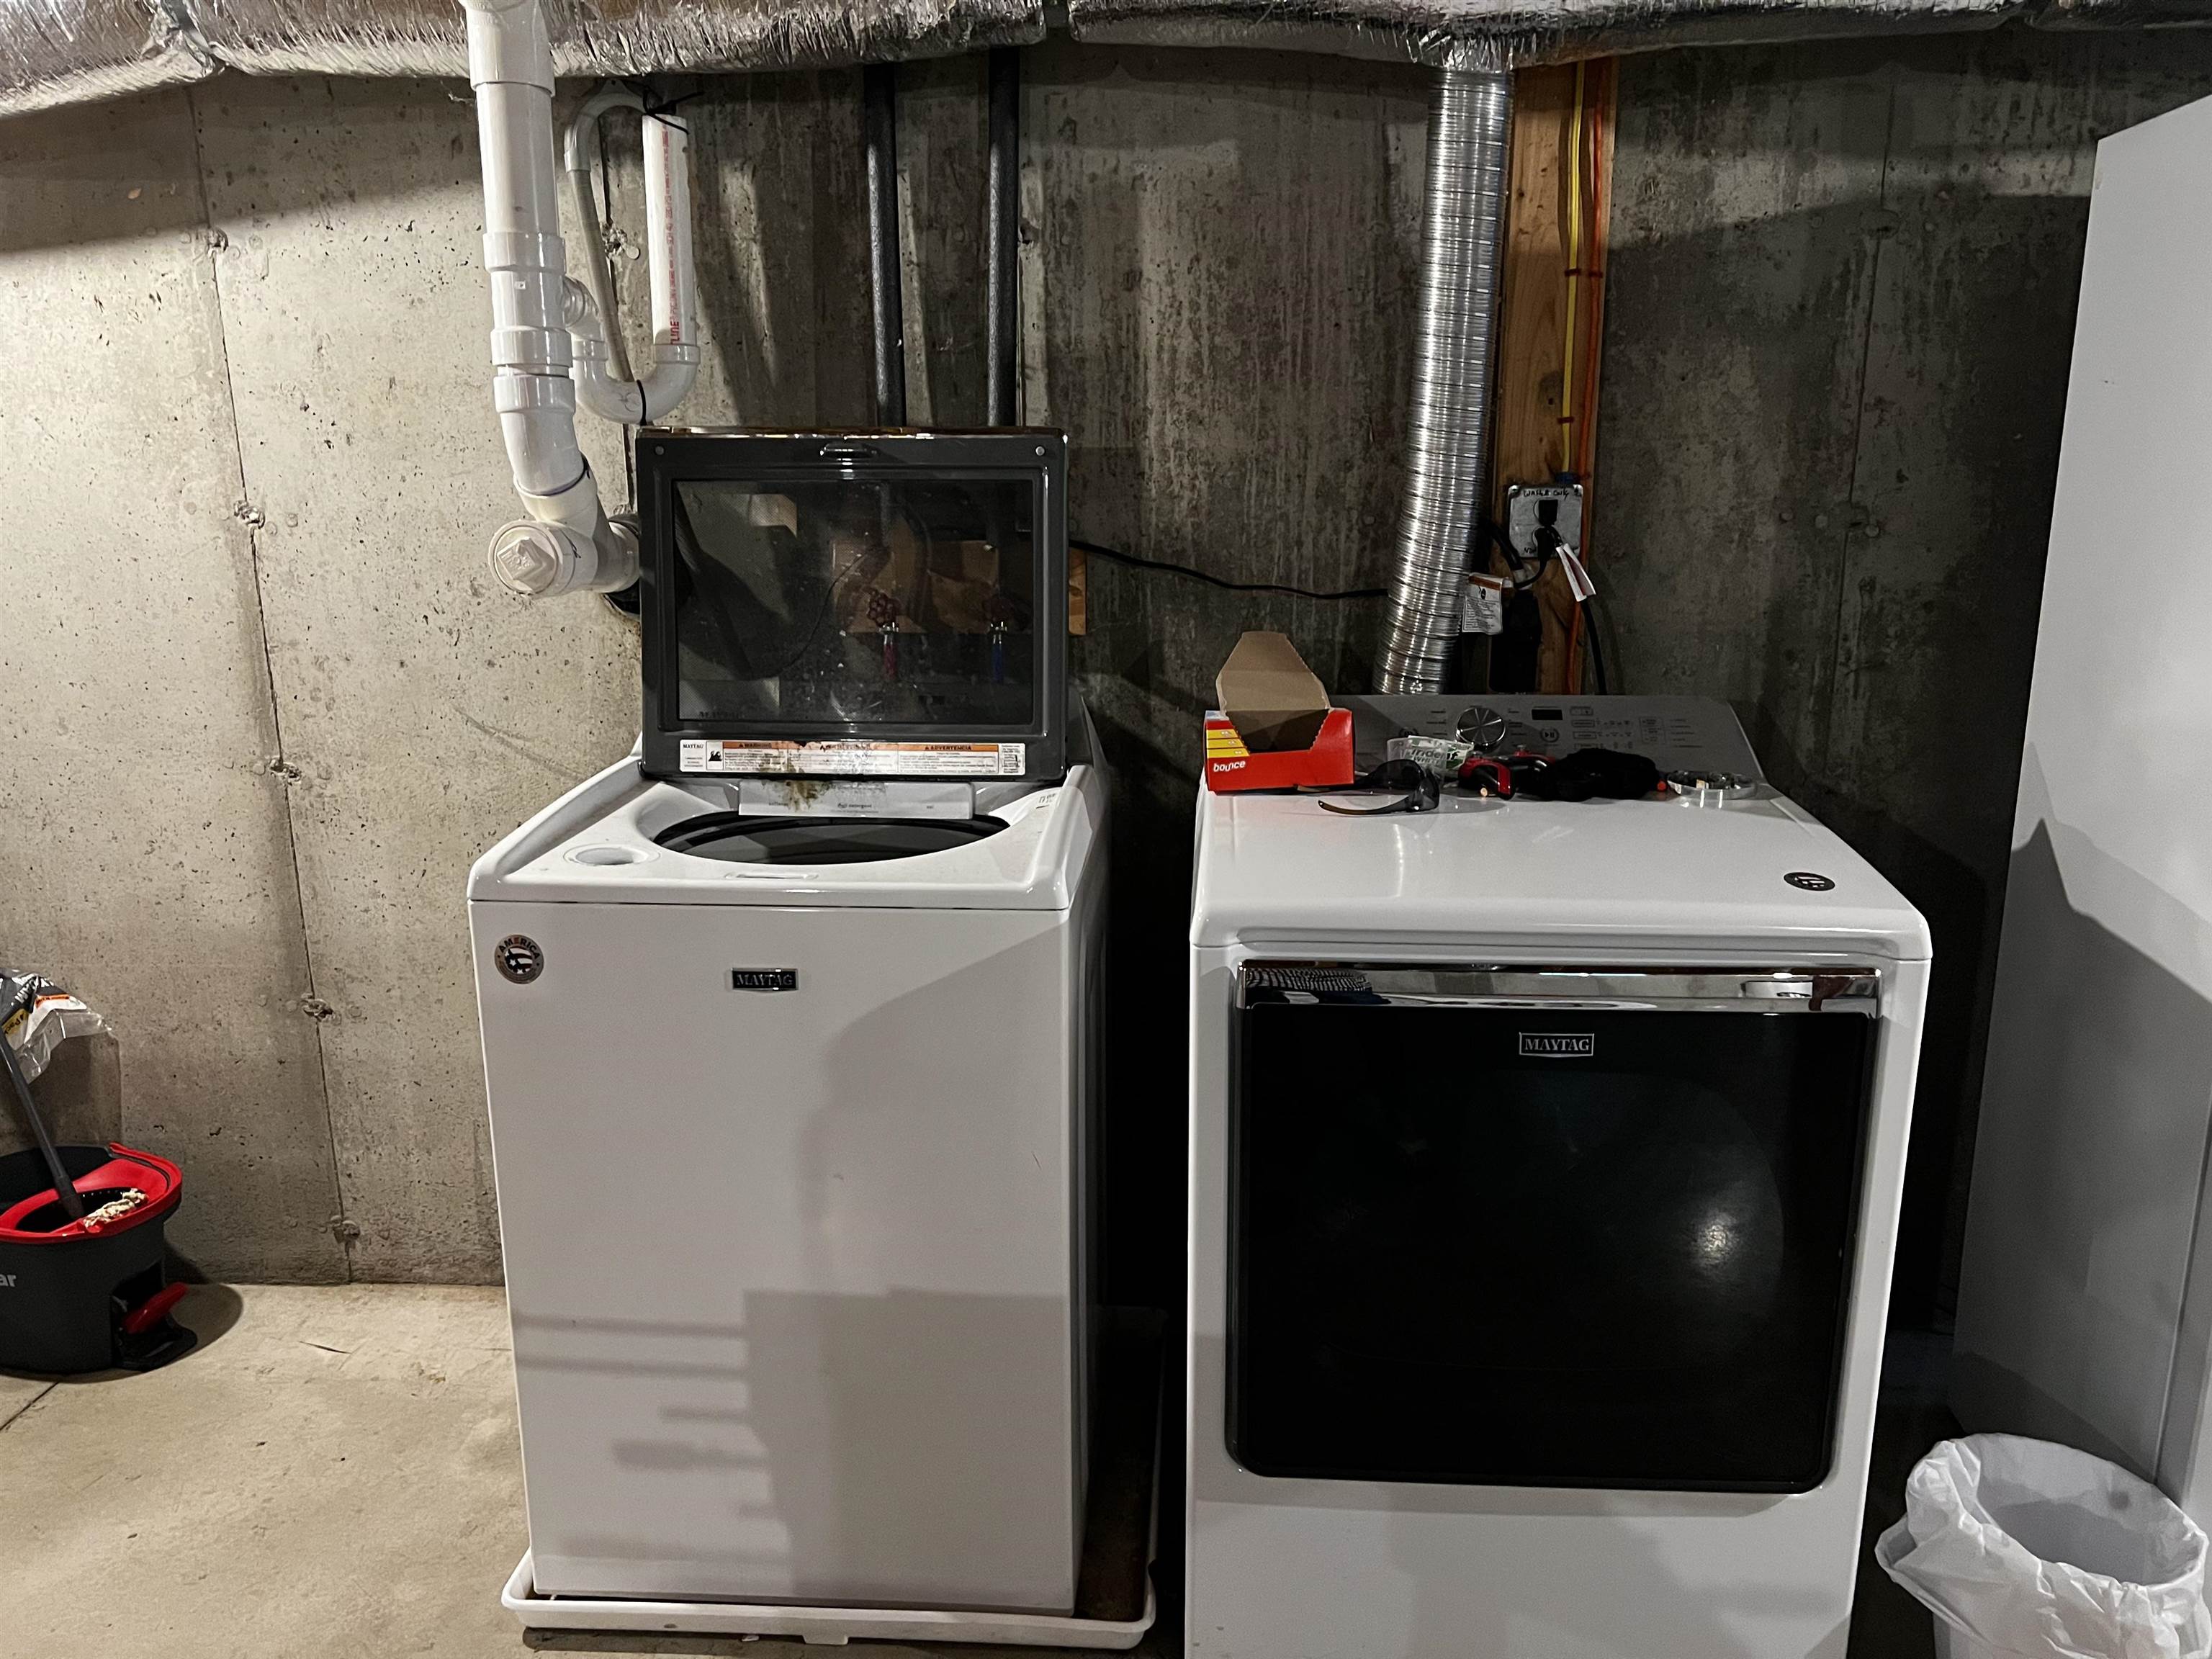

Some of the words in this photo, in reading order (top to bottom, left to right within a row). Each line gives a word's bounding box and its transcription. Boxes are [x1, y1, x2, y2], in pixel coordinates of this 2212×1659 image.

[1213, 760, 1246, 772] bounce
[499, 937, 541, 960] AMERICA
[737, 974, 793, 986] MAYTAG
[1524, 1038, 1590, 1051] MAYTAG
